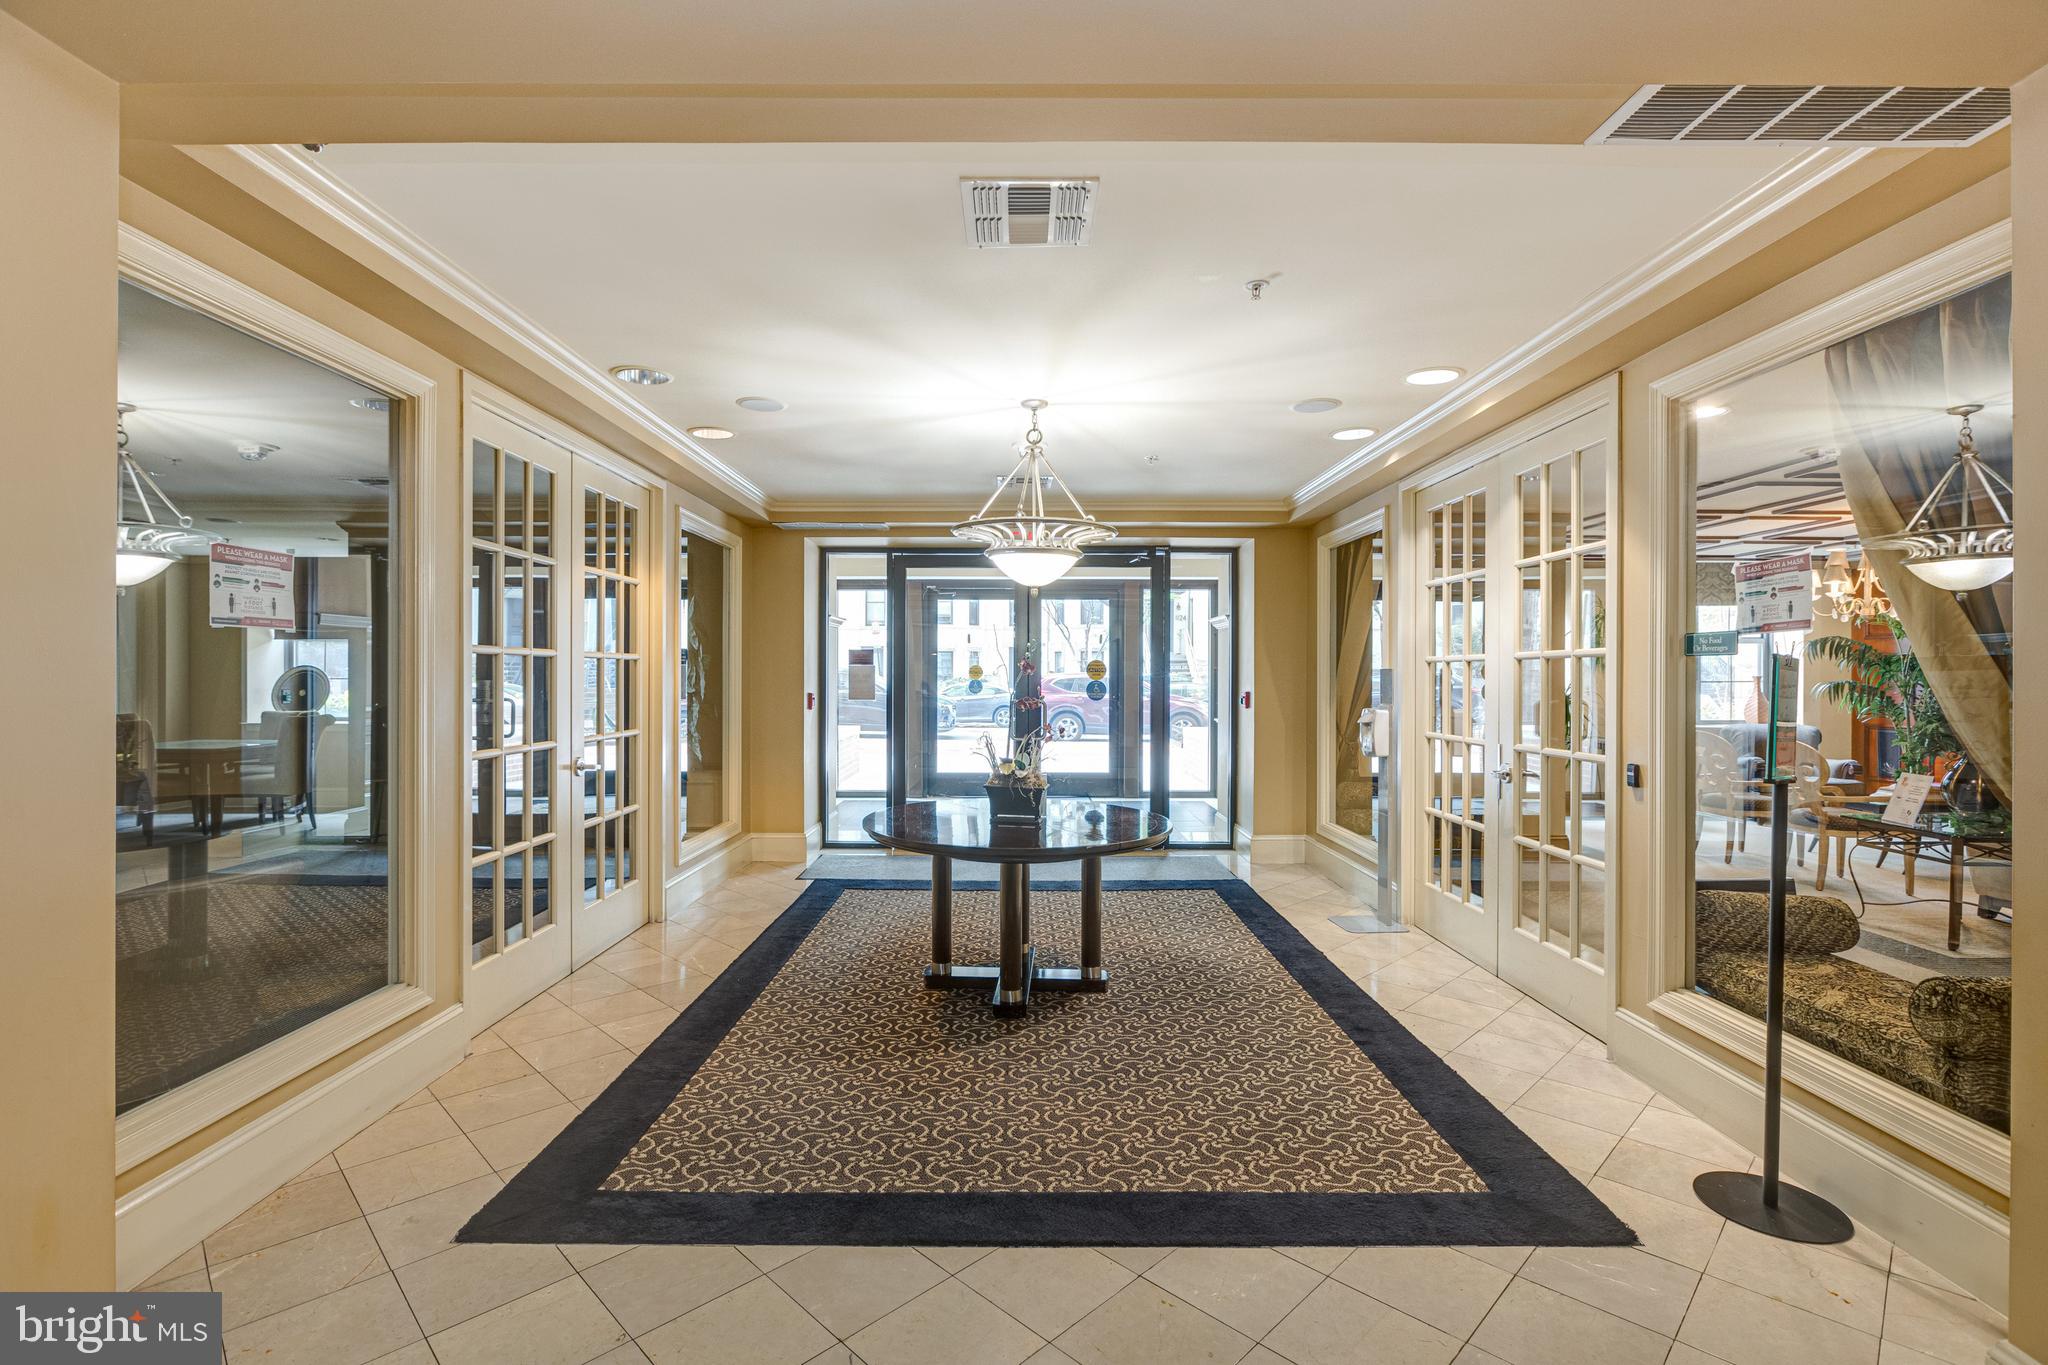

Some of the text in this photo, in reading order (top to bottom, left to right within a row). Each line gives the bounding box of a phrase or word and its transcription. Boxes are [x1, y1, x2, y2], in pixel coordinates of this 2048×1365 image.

[217, 546, 243, 557] PLEASE
[244, 550, 263, 560] WEAR
[269, 554, 288, 563] MASK
[1740, 564, 1762, 576] PLEASE
[1762, 560, 1781, 571] WEAR
[1786, 557, 1805, 567] MASK
[1709, 636, 1722, 644] Food
[1702, 644, 1728, 653] Beverages
